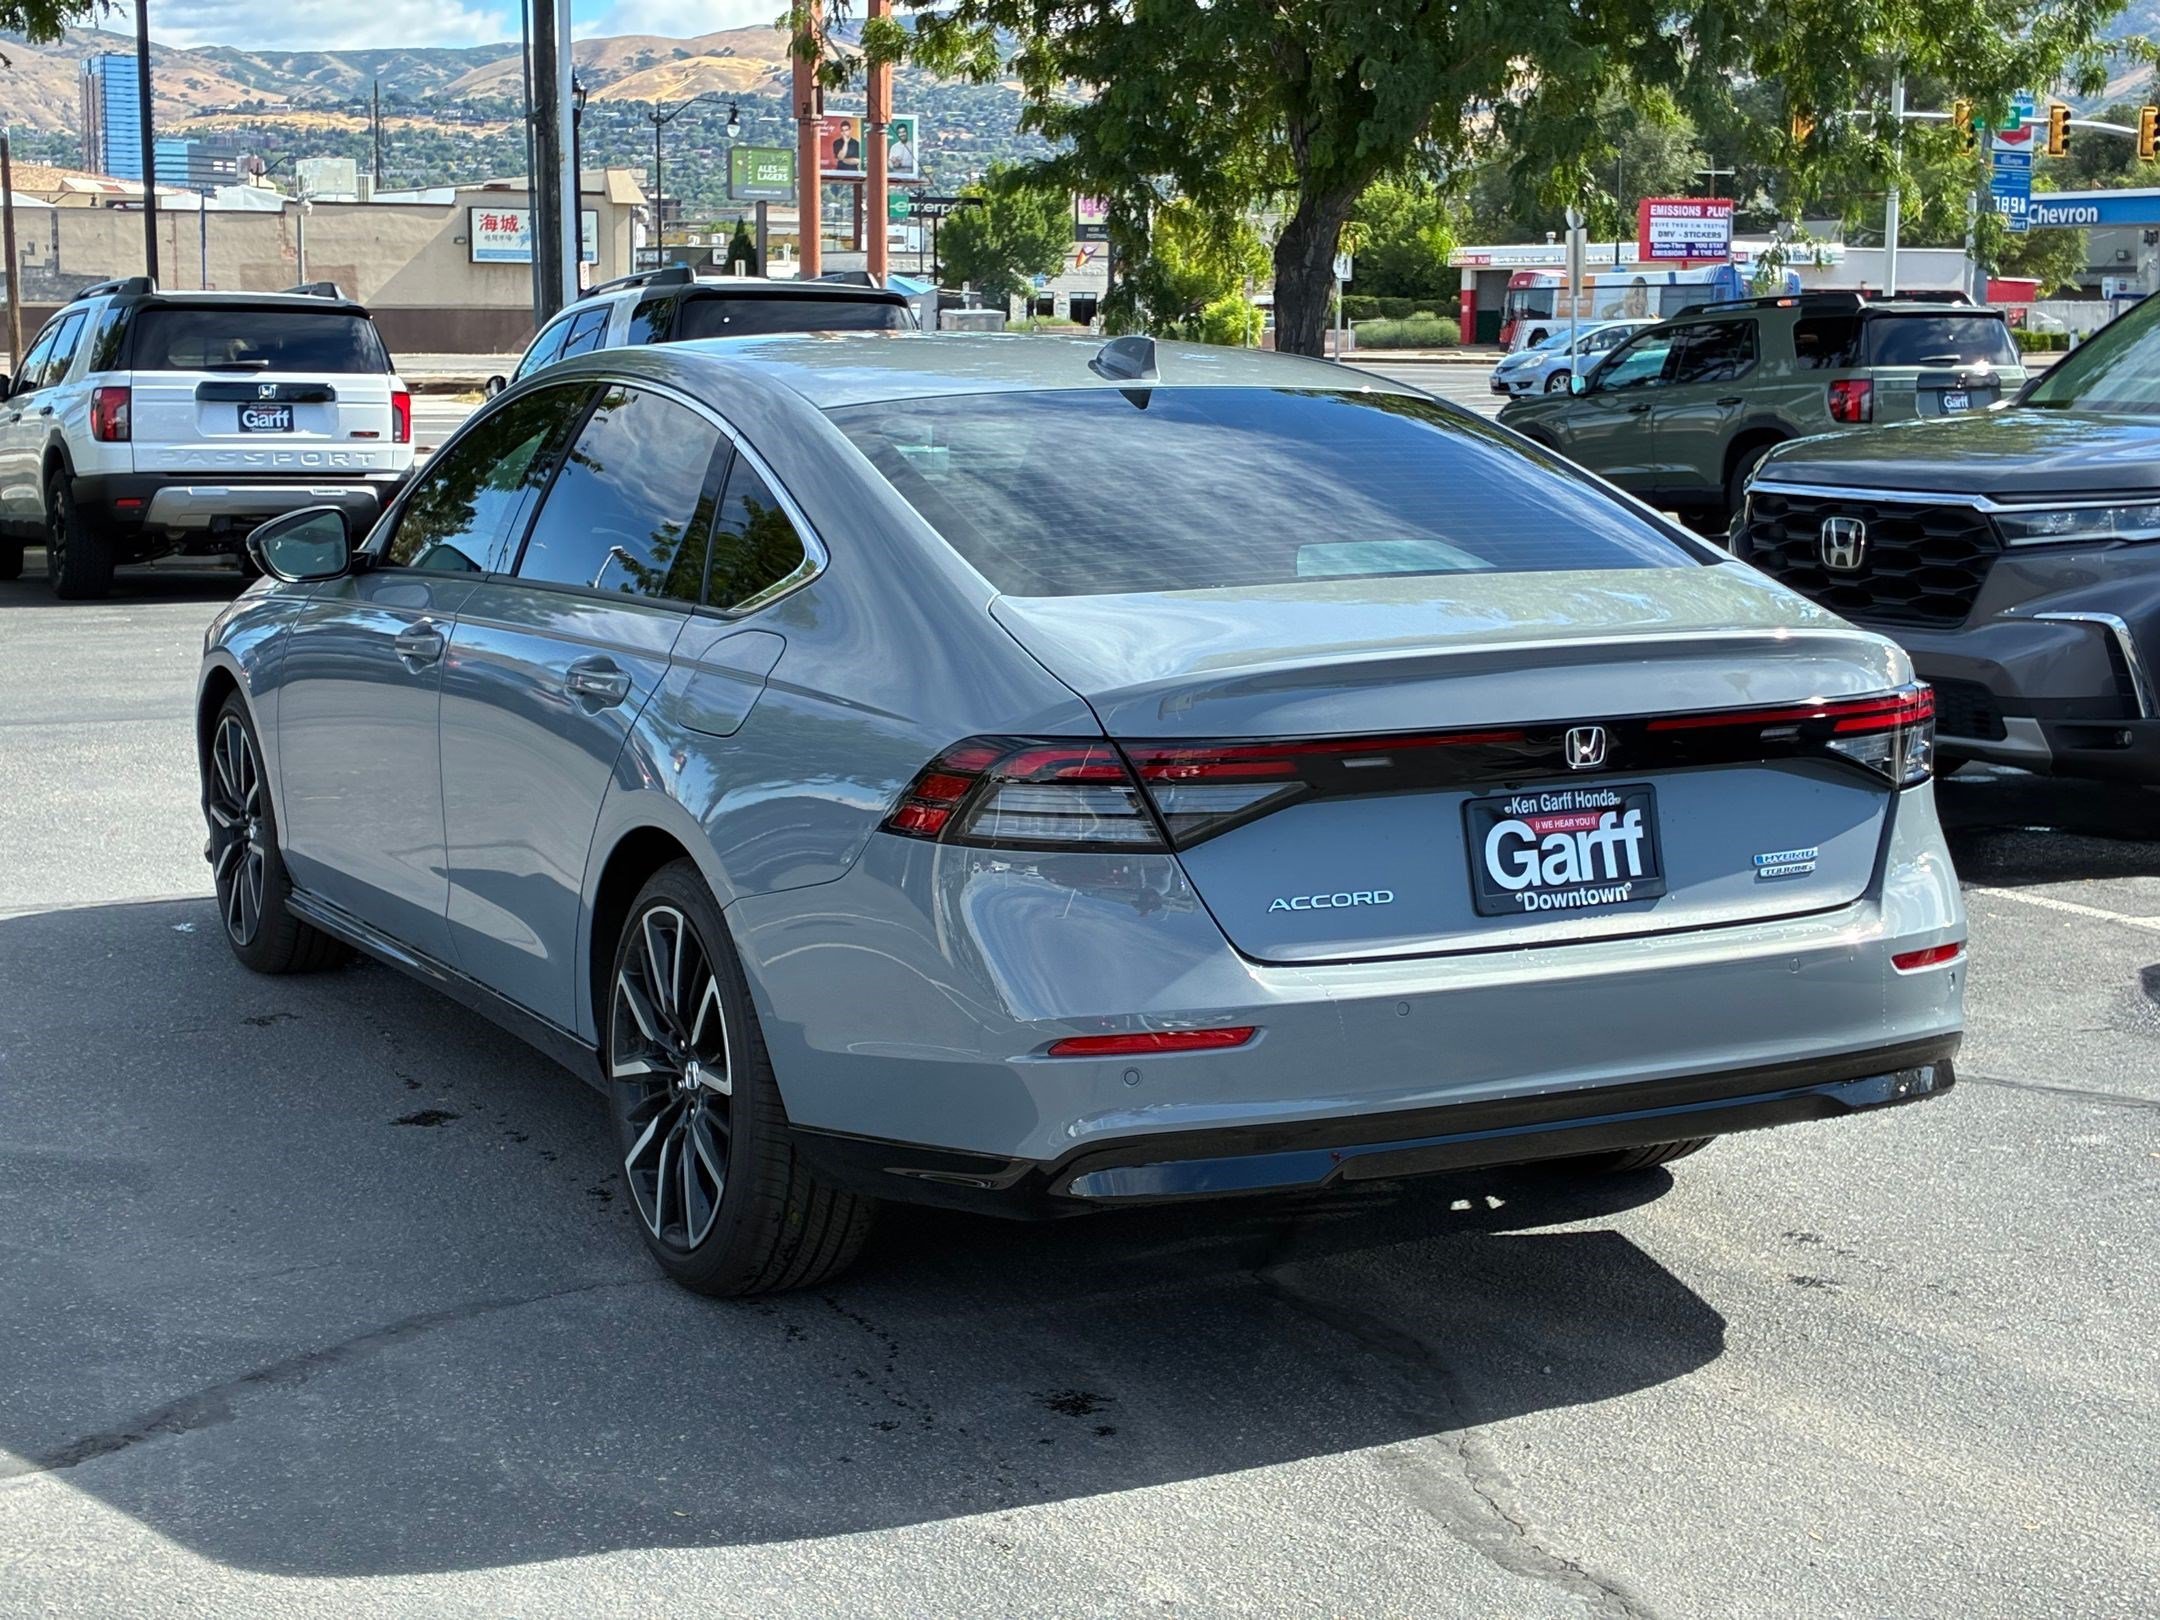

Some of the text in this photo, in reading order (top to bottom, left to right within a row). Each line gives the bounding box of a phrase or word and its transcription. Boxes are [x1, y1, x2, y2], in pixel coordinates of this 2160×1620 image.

[1650, 205, 1730, 218] EMISSIONS PLUS
[2029, 204, 2098, 224] Chevron
[479, 213, 519, 233] 海城
[1943, 395, 1969, 409] Garff
[242, 410, 289, 428] Garff
[157, 451, 376, 467] PASSPORT
[1511, 789, 1615, 815] Ken Garff Honda
[1541, 817, 1591, 829] WE HEAR YOU
[1485, 809, 1643, 890] Garff
[1764, 850, 1815, 863] HYBRID
[1764, 864, 1814, 875] TOURING
[1268, 890, 1394, 913] ACCORD
[1524, 886, 1628, 911] Downtown
